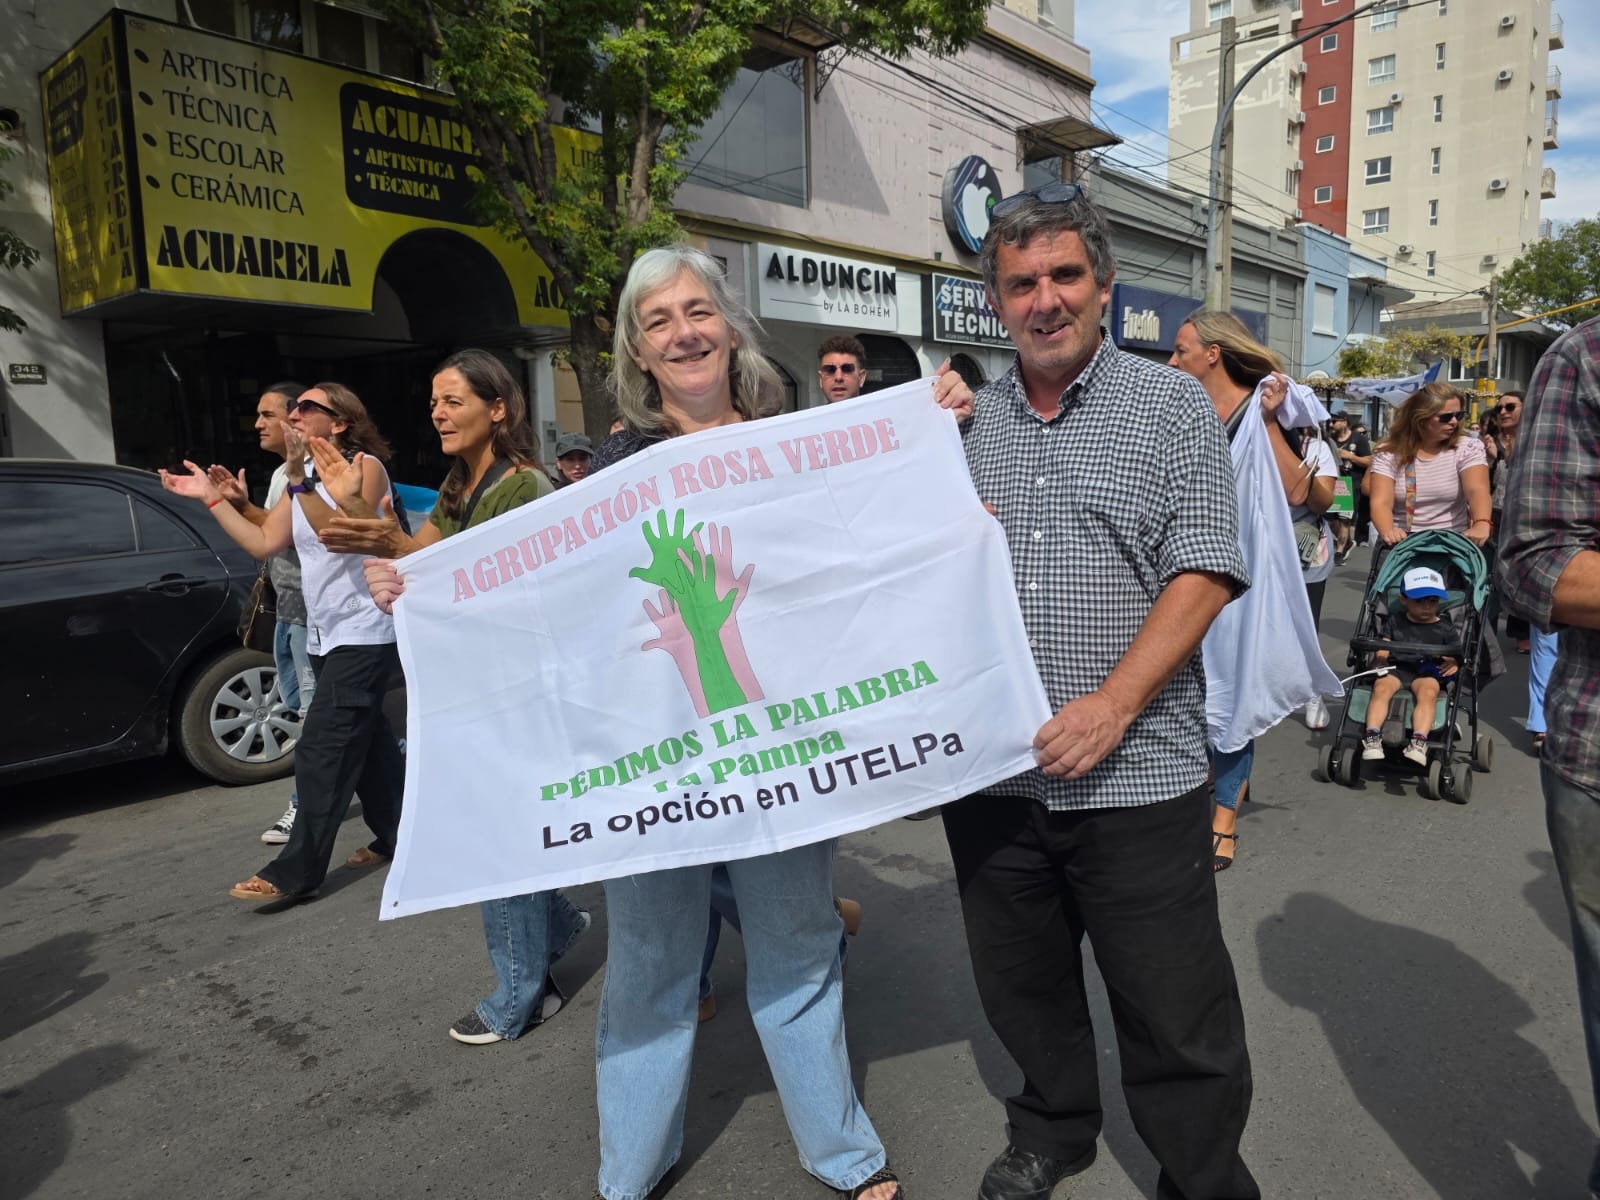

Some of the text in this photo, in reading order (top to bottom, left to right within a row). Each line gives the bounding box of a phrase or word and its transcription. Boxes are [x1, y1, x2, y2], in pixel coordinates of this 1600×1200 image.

[162, 86, 277, 136] TÉCNICA
[352, 99, 510, 162] ACUARE
[166, 130, 285, 175] ESCOLAR
[365, 147, 455, 180] ARTISTICA
[171, 172, 304, 216] CERÁMICA
[366, 170, 440, 201] TÉCNICA
[157, 225, 351, 287] ACUARELA
[766, 252, 897, 296] ALDUNCIN
[823, 300, 834, 314] by
[837, 301, 850, 313] LA
[940, 284, 993, 311] SERV
[452, 416, 901, 603] AGRUPACIÓN ROSA VERDE
[540, 660, 939, 801] PEDIMOS LA PALABRA
[708, 726, 846, 785] Pampa
[542, 730, 965, 850] La opción en UTELPa
